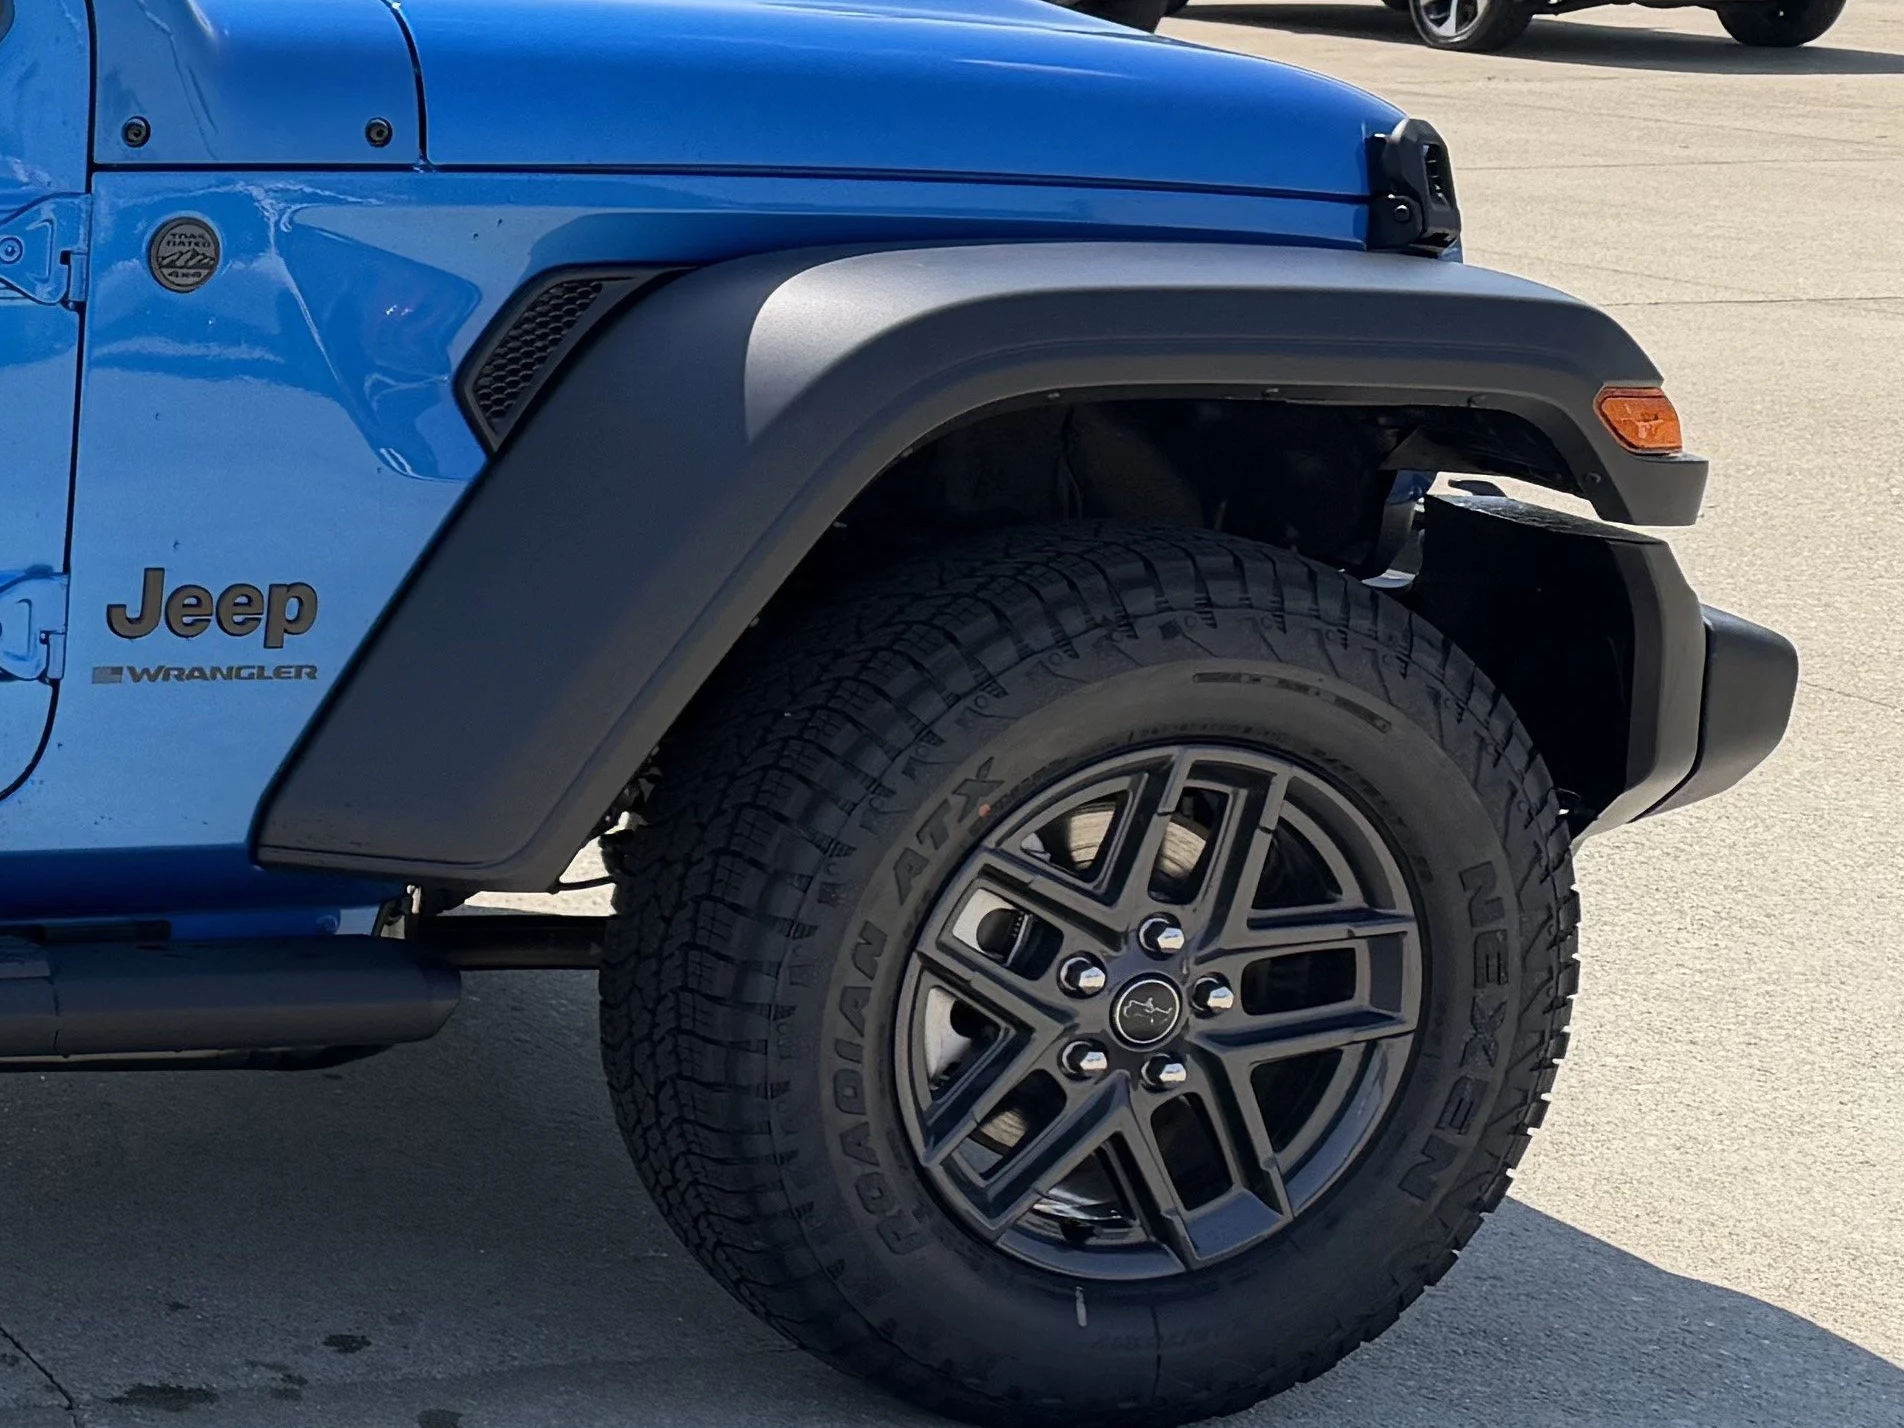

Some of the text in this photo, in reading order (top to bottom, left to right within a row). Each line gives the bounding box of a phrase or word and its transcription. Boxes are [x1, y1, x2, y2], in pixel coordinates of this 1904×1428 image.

[106, 567, 318, 649] Jeep
[126, 665, 319, 682] WRANGLER
[1398, 861, 1510, 1203] NEXEN
